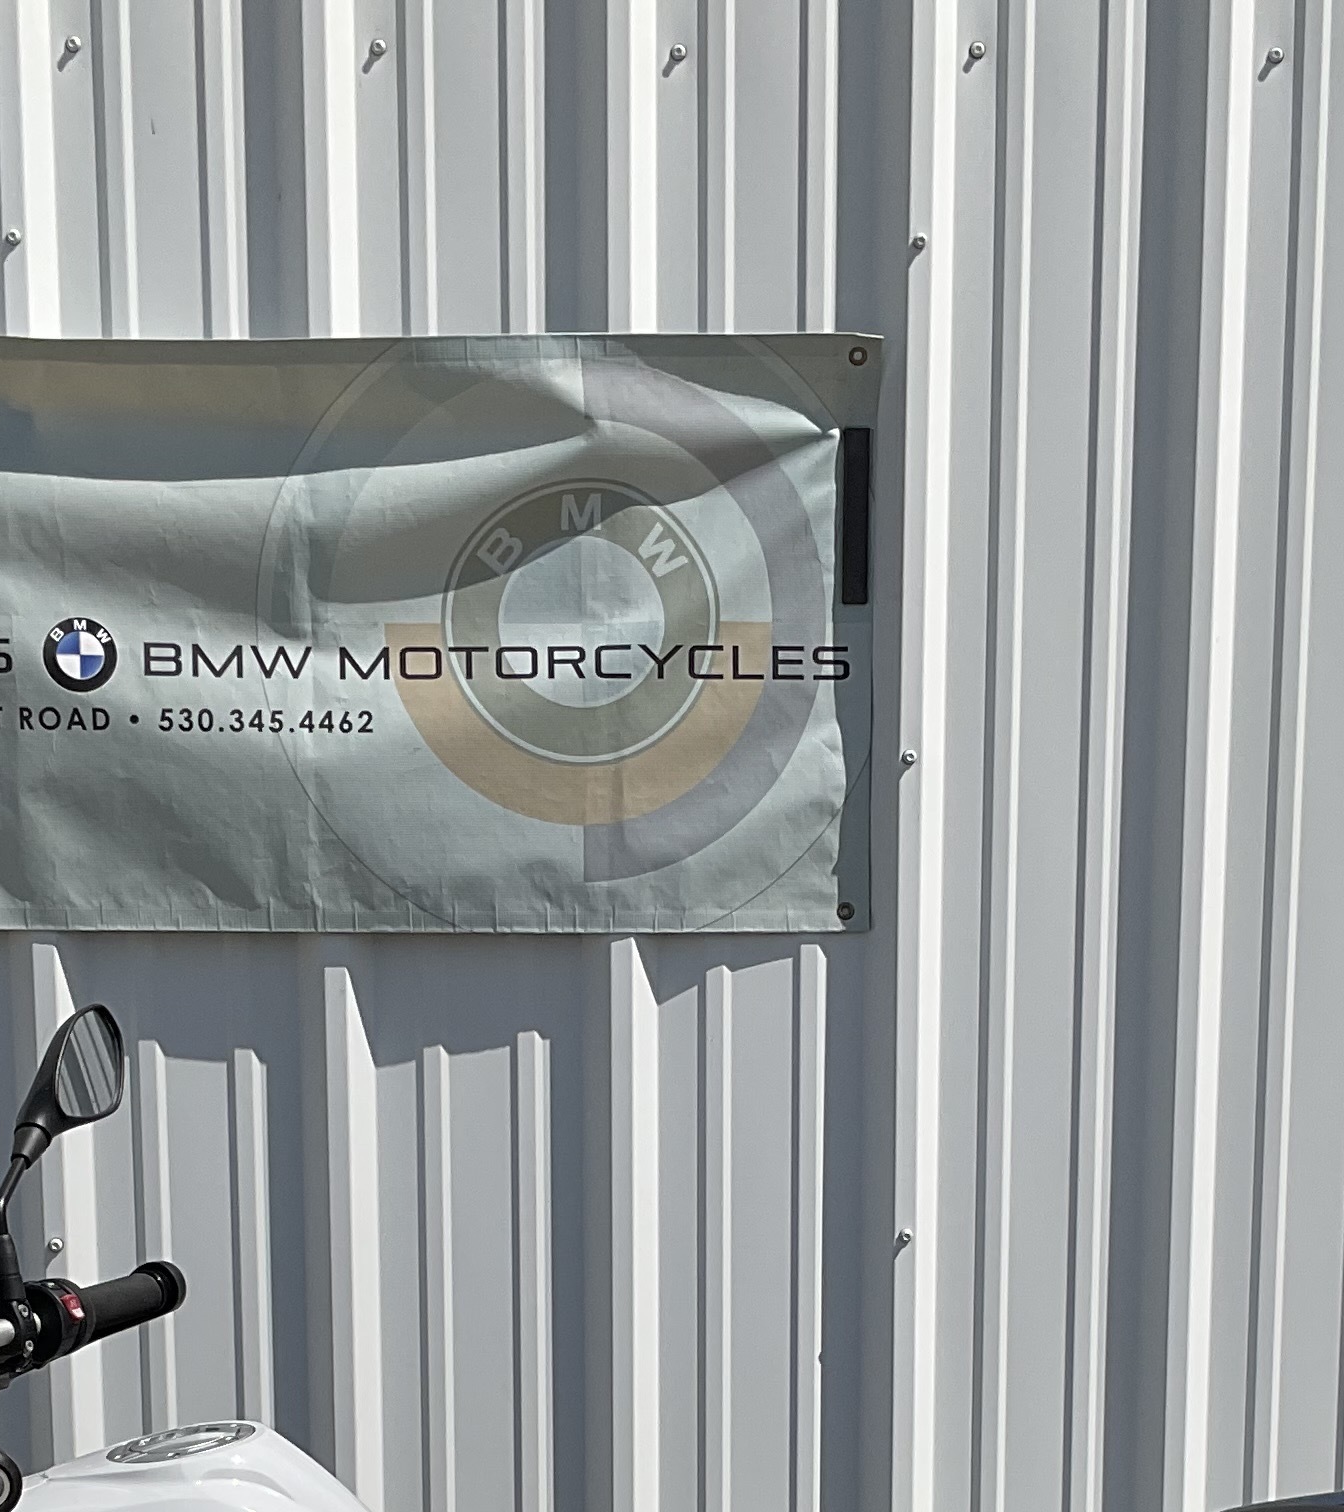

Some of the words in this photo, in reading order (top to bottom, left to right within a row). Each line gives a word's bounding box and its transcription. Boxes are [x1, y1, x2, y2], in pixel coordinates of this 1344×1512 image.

[475, 493, 690, 578] BMW
[49, 618, 113, 643] BMW
[142, 641, 314, 680] BMW
[337, 643, 851, 681] MOTORCYCLES
[19, 707, 111, 732] ROAD
[158, 707, 375, 734] 530.345.4462
